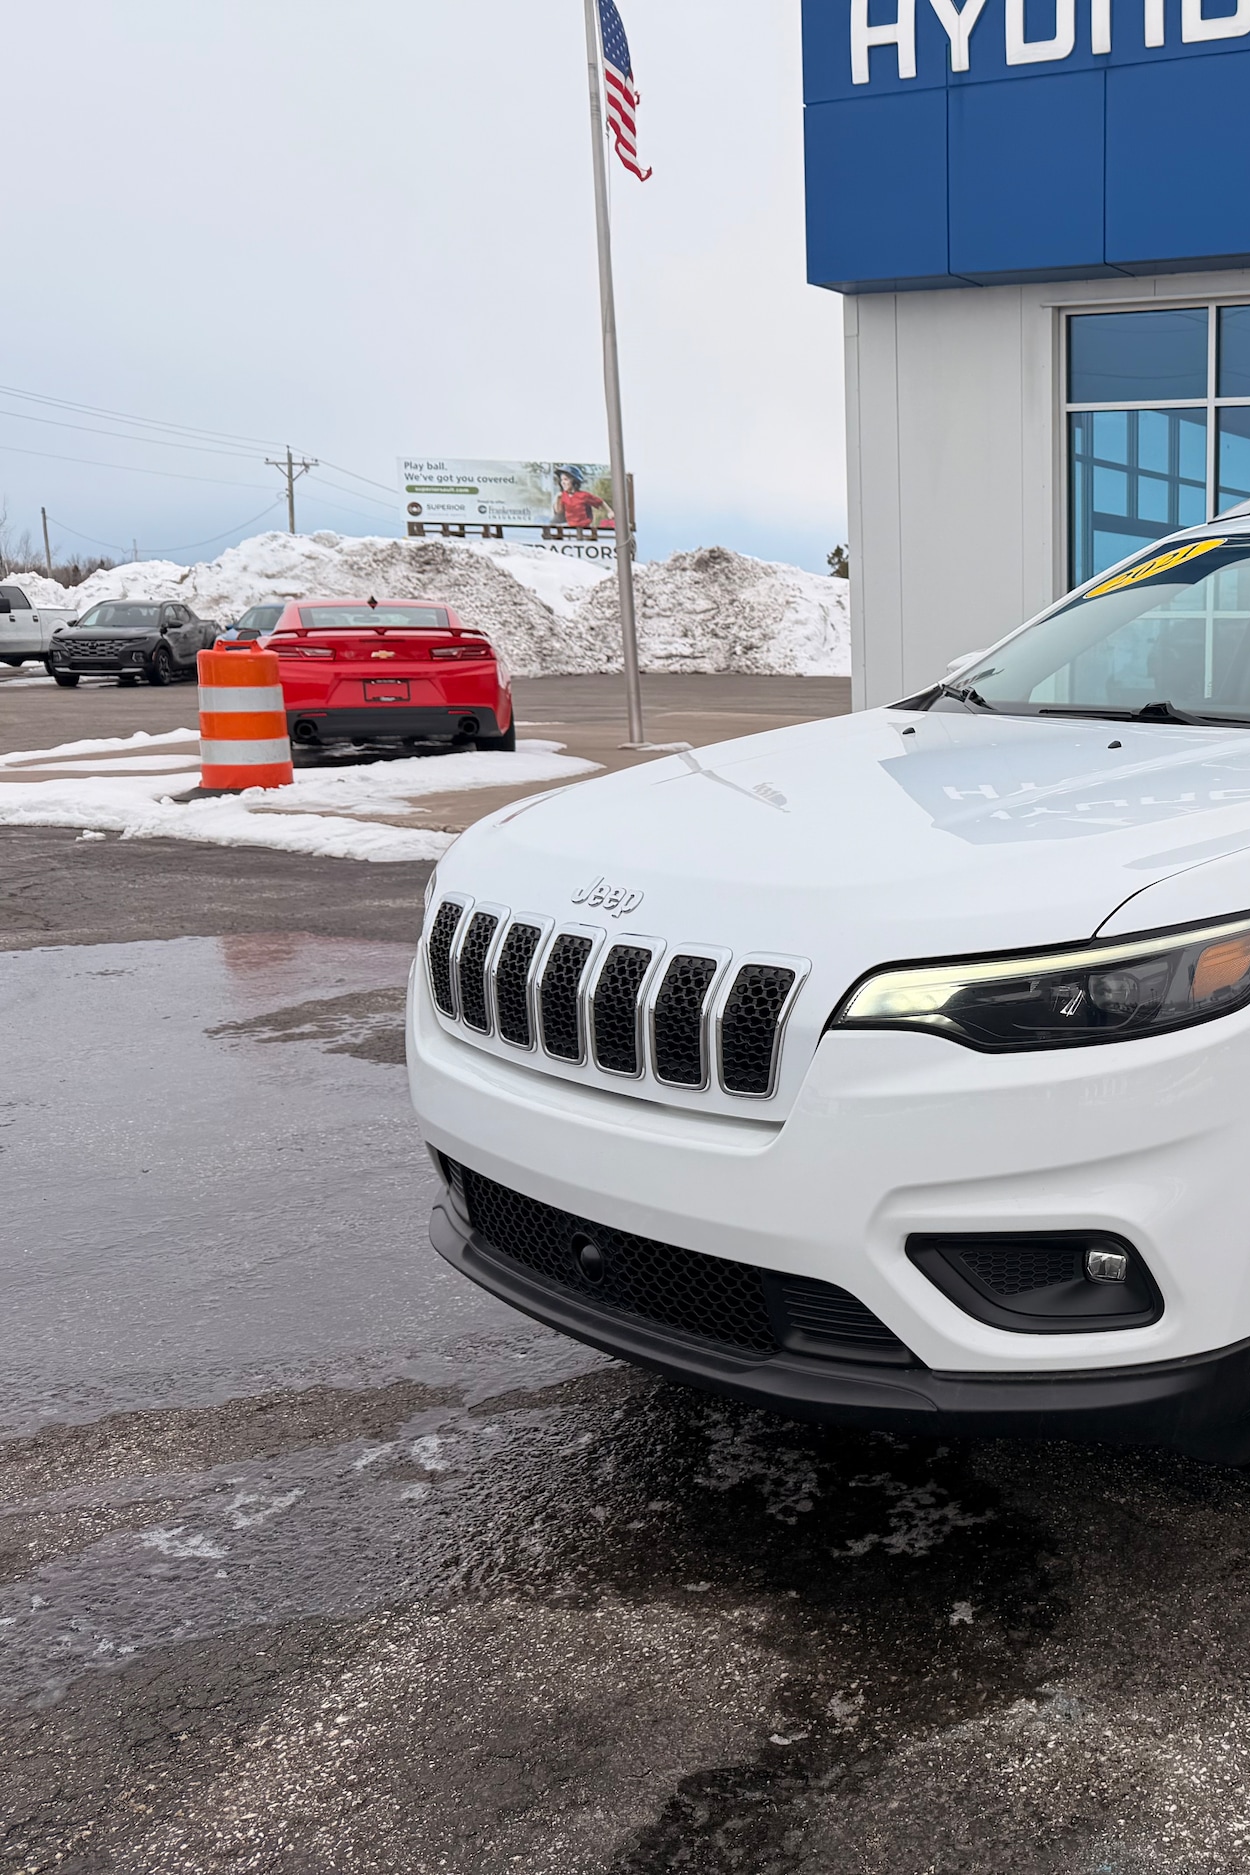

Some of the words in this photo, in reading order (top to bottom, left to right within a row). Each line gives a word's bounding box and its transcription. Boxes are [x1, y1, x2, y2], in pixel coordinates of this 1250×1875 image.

[404, 461, 424, 472] Play
[427, 461, 448, 471] ball.
[404, 472, 434, 482] We've
[436, 474, 454, 484] got
[456, 475, 474, 485] you
[477, 475, 518, 485] covered.
[426, 503, 466, 512] SUPERIOR
[1102, 542, 1202, 592] 2021
[570, 875, 645, 919] Jeep
